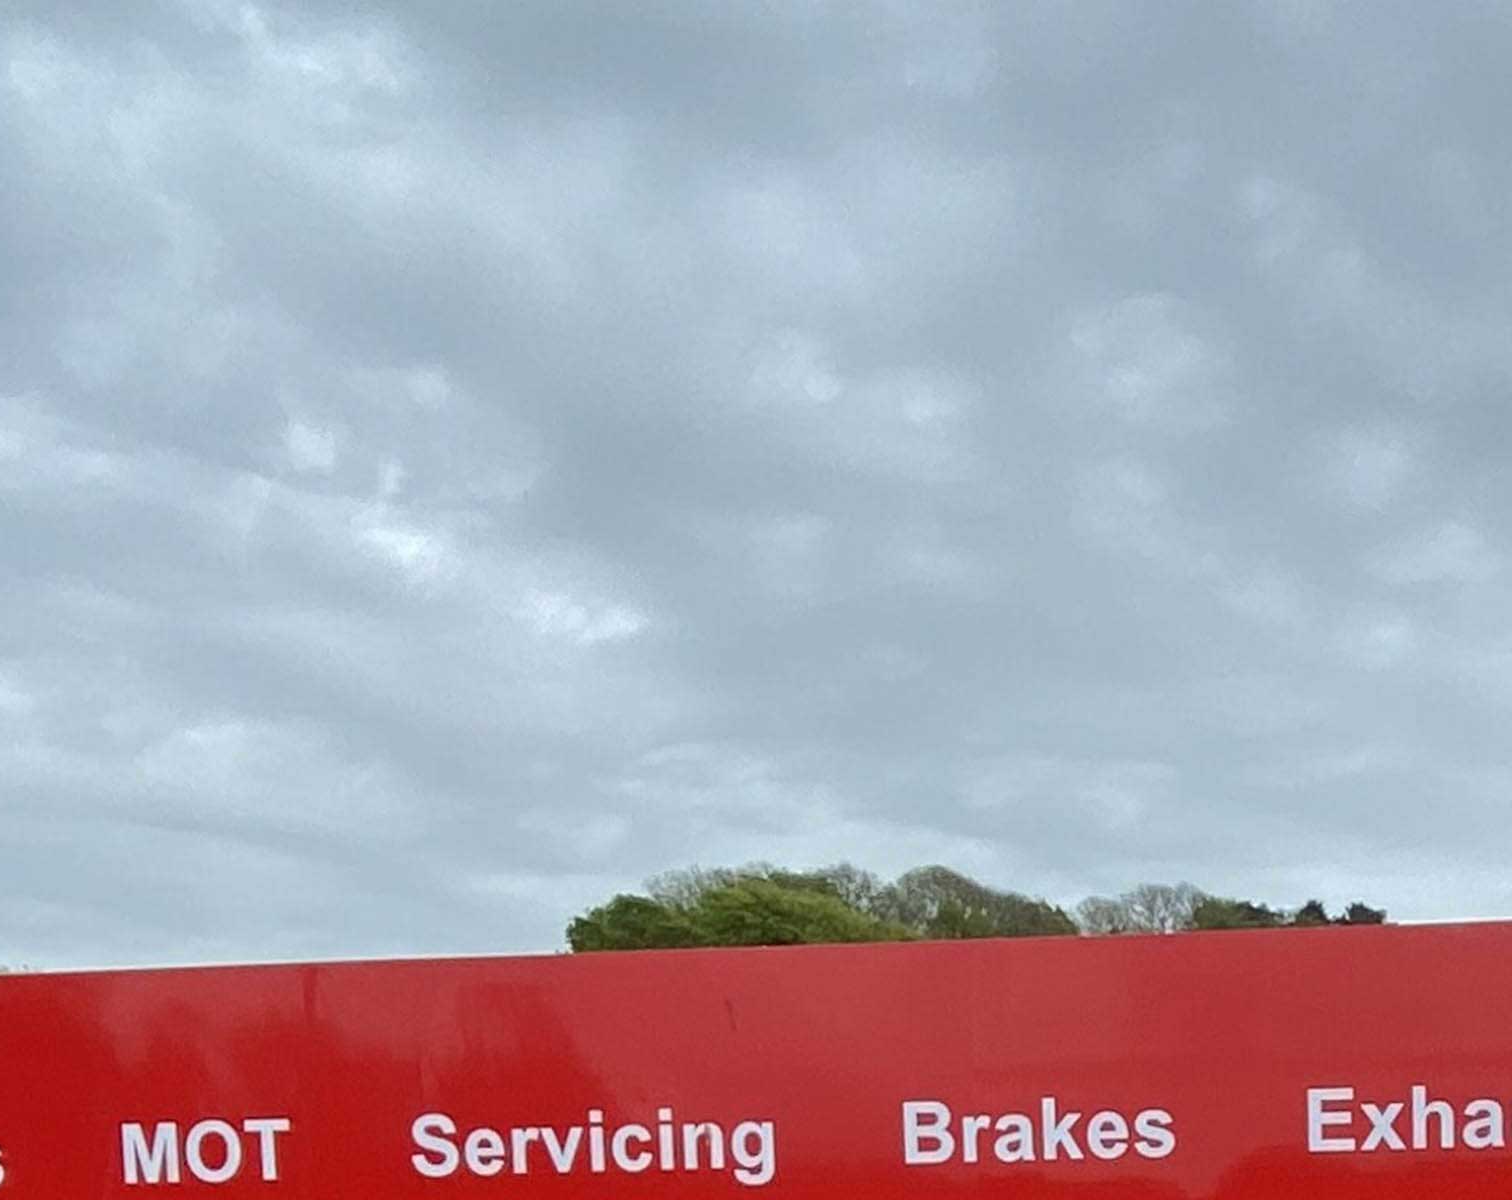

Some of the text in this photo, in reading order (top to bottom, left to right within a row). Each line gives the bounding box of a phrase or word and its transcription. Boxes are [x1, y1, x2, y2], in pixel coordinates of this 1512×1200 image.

[121, 1117, 290, 1184] MOT
[411, 1107, 776, 1185] Servicing
[901, 1096, 1177, 1166] Brakes
[1306, 1085, 1506, 1153] Exha
